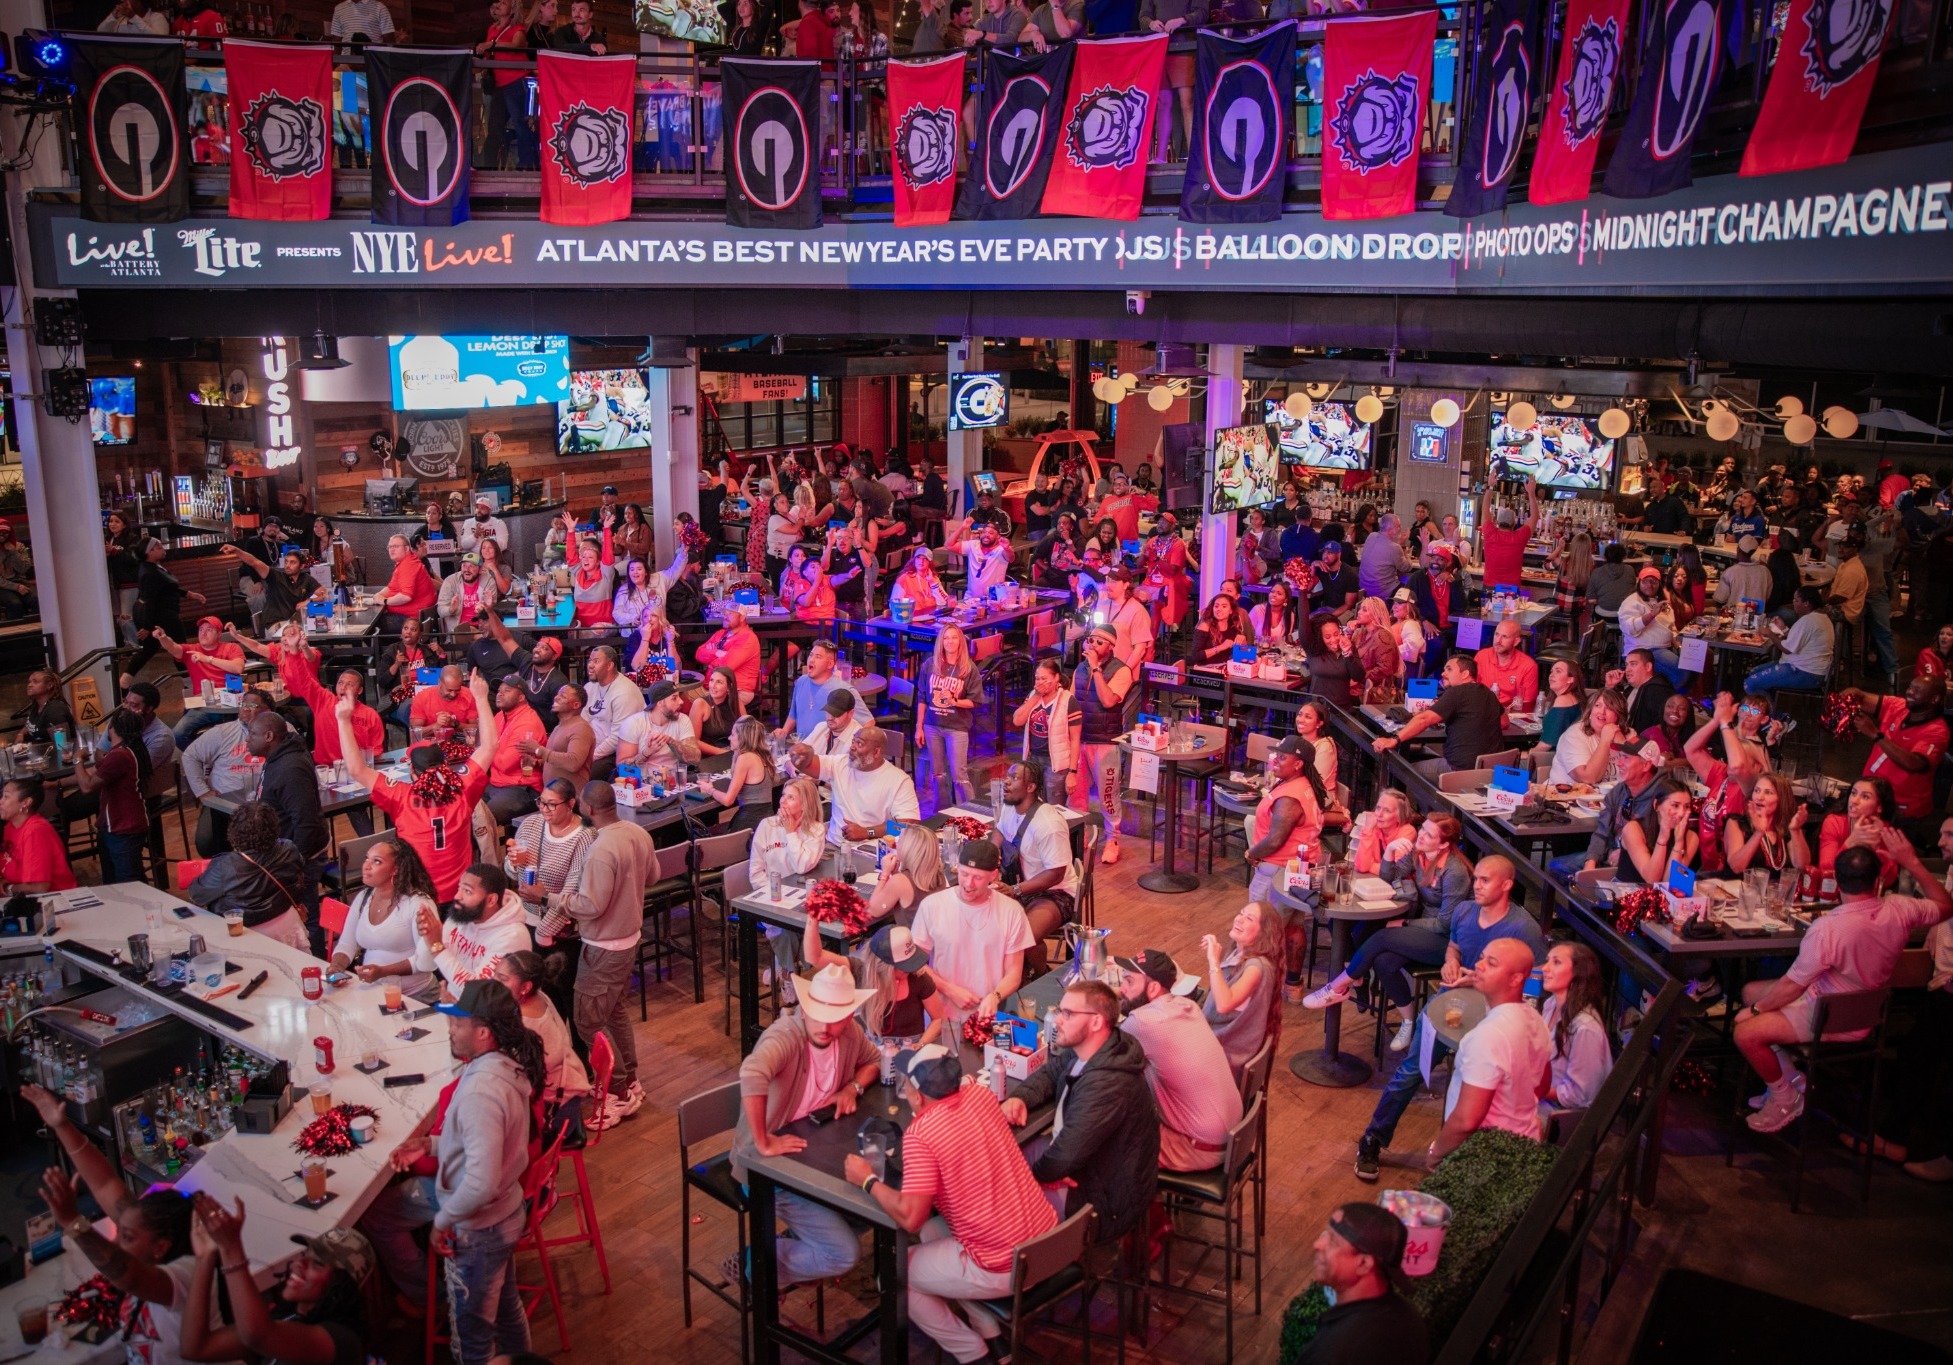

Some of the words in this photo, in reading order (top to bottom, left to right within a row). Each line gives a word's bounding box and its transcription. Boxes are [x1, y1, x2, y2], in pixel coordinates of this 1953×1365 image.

[536, 239, 707, 263] ATLANTA'S
[713, 240, 794, 263] BEST
[800, 241, 863, 263] NEW
[866, 240, 955, 262] YEAR'S
[960, 239, 1011, 261] EVE
[1017, 237, 1108, 261] PARTY
[1195, 233, 1353, 260] BALLOON
[1362, 233, 1462, 260] DROP
[1474, 225, 1532, 258] PHOTO
[1533, 221, 1575, 255] OPS
[1592, 207, 1716, 251] MIDNIGHT
[1717, 181, 1953, 245] CHAMPAGNE
[177, 228, 216, 247] Miller
[68, 228, 155, 266] Live!
[276, 247, 342, 257] PRESENTS
[350, 231, 419, 273] NYE
[424, 233, 514, 272] Live!
[194, 237, 262, 277] Lite
[110, 260, 160, 268] BATTERY
[110, 268, 162, 276] ATLANTA
[467, 341, 518, 352] LEMON
[753, 379, 797, 389] BASEBALL
[762, 389, 789, 399] FANS!
[418, 427, 449, 446] Coors
[423, 443, 445, 453] LIGHT
[428, 542, 451, 550] RESERVED
[77, 693, 97, 701] CAUTION
[1104, 777, 1116, 815] TIGERS
[1496, 793, 1514, 804] Coors
[430, 816, 446, 851] 1
